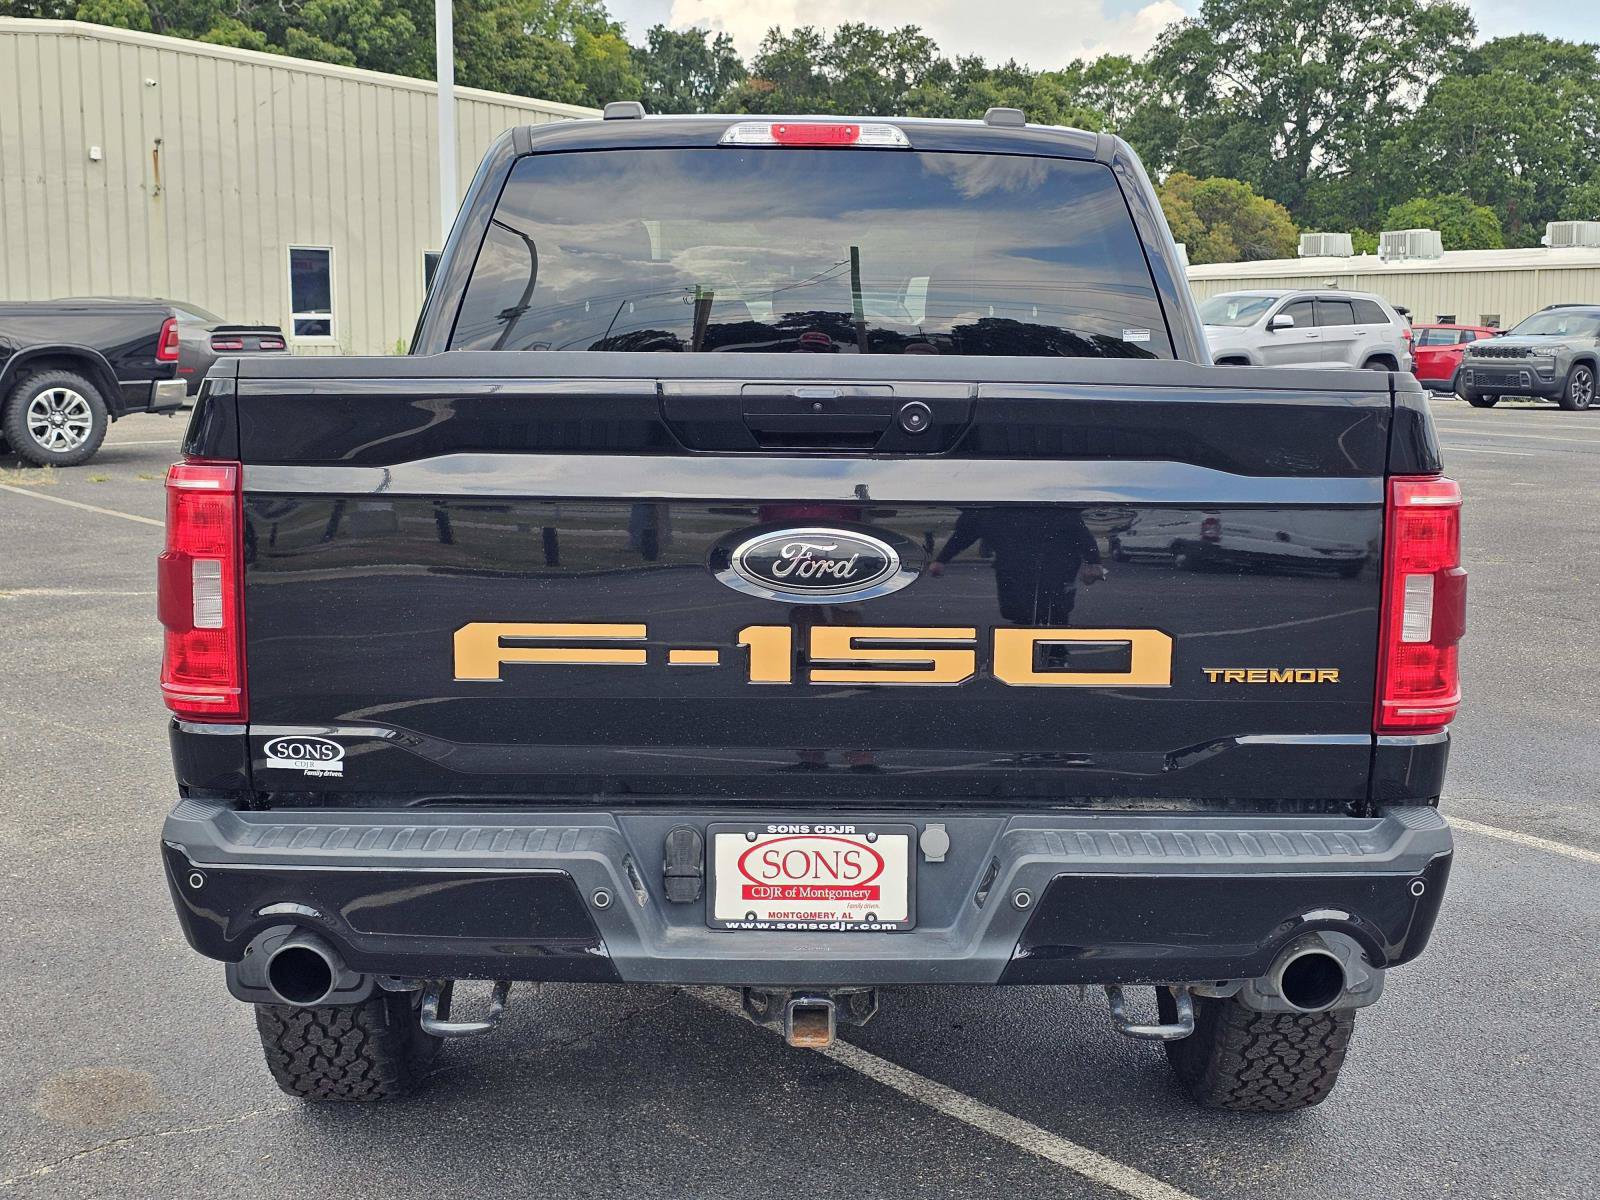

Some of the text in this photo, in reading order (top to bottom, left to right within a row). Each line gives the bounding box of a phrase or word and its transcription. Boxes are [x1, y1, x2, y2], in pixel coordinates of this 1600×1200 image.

[772, 542, 860, 578] Ford
[453, 622, 1173, 687] F-150
[1202, 667, 1340, 683] TREMOR
[277, 743, 333, 759] SONS
[304, 769, 323, 777] Family
[767, 825, 856, 834] SONS CDJR
[762, 849, 862, 880] SONS
[751, 886, 871, 900] CDJR of Montgomery
[847, 902, 863, 910] Family
[768, 911, 854, 920] MONTGOMERY, AL
[725, 921, 897, 931] www.sonscdjr.com
